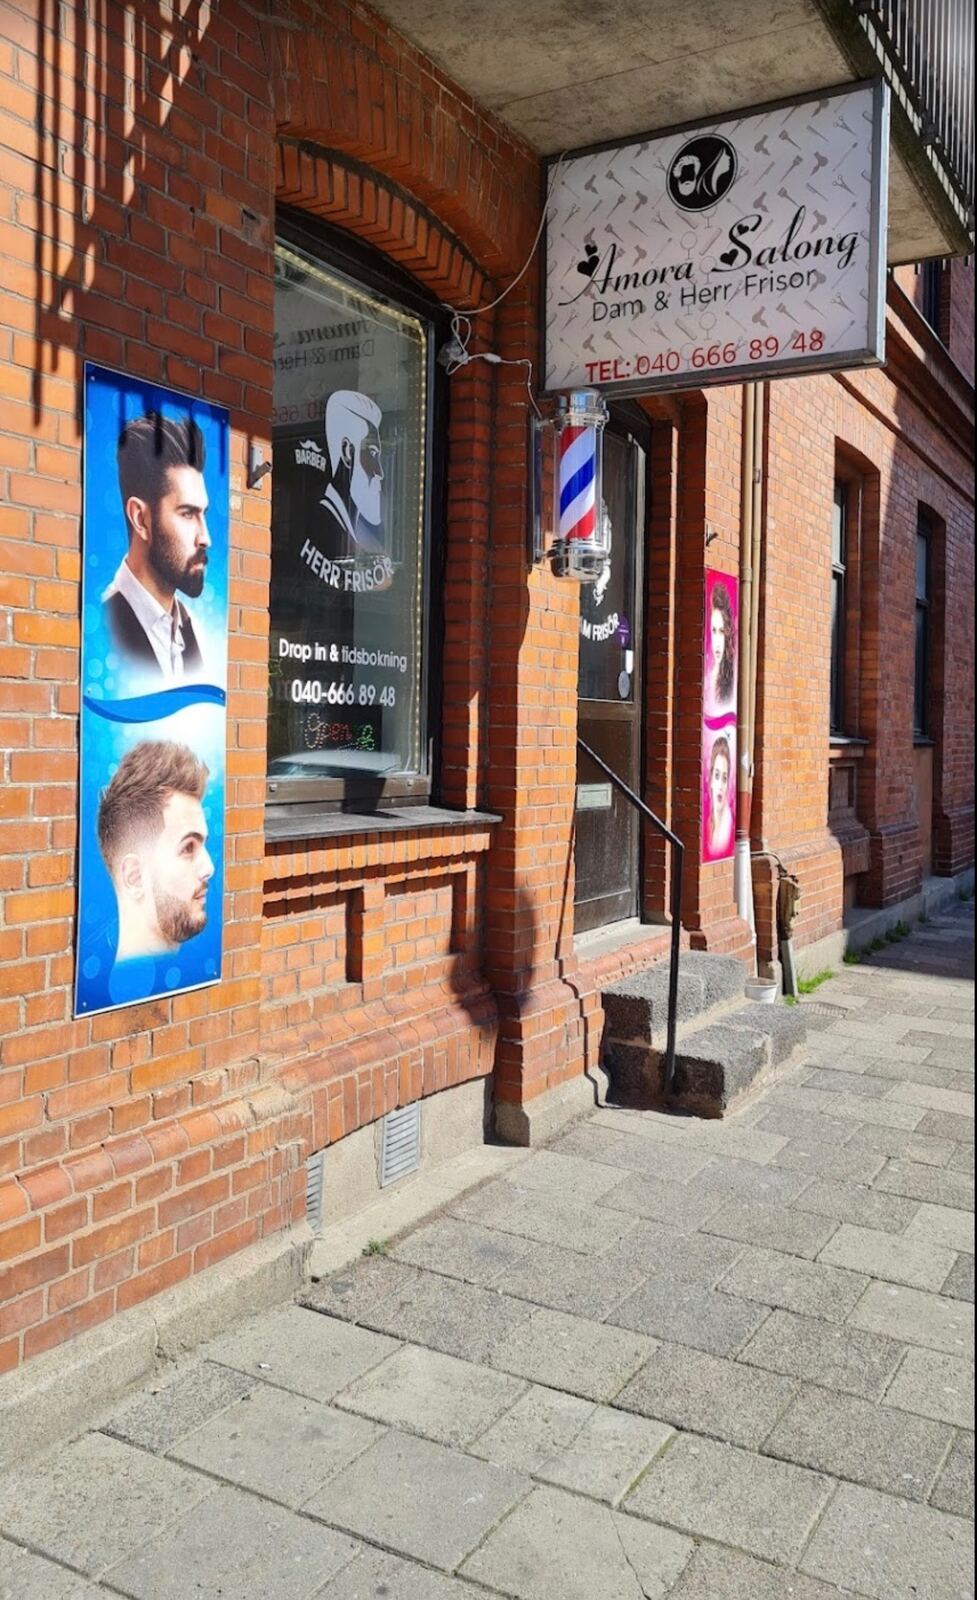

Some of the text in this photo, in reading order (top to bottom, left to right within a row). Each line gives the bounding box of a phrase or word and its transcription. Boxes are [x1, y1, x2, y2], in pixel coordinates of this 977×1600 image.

[558, 204, 859, 306] Amora Salong
[592, 269, 818, 322] Dam & Herr Frisor
[585, 329, 824, 383] TEL: 040 666 89 48
[294, 448, 327, 473] BARBER
[300, 538, 395, 593] HERR FRISÖR
[279, 638, 408, 673] Drop in & tidsbokning
[291, 679, 396, 708] 040-666 89 48
